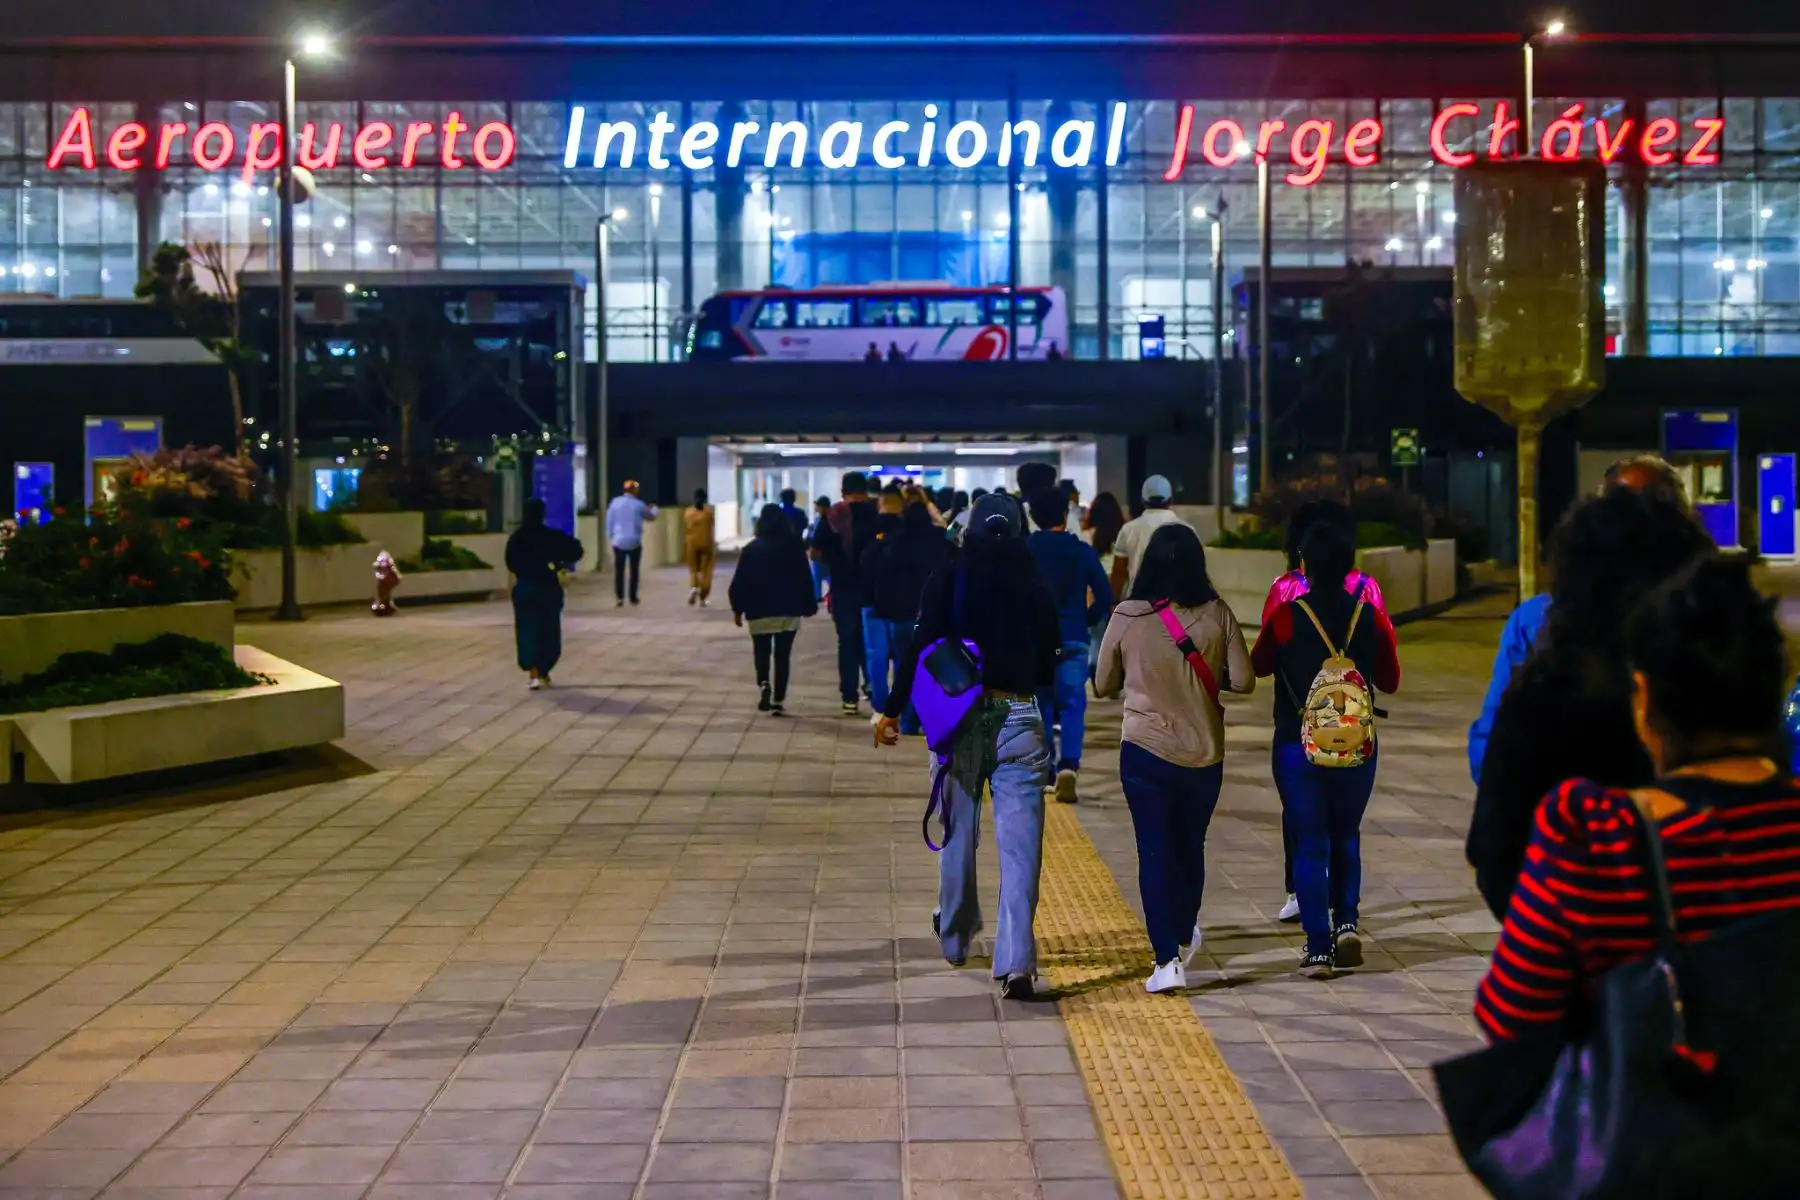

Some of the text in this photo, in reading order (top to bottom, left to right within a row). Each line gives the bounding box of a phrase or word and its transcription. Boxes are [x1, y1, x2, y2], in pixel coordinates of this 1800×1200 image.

[47, 101, 1725, 186] Aeropuerto Internacional Jorge Chávez
